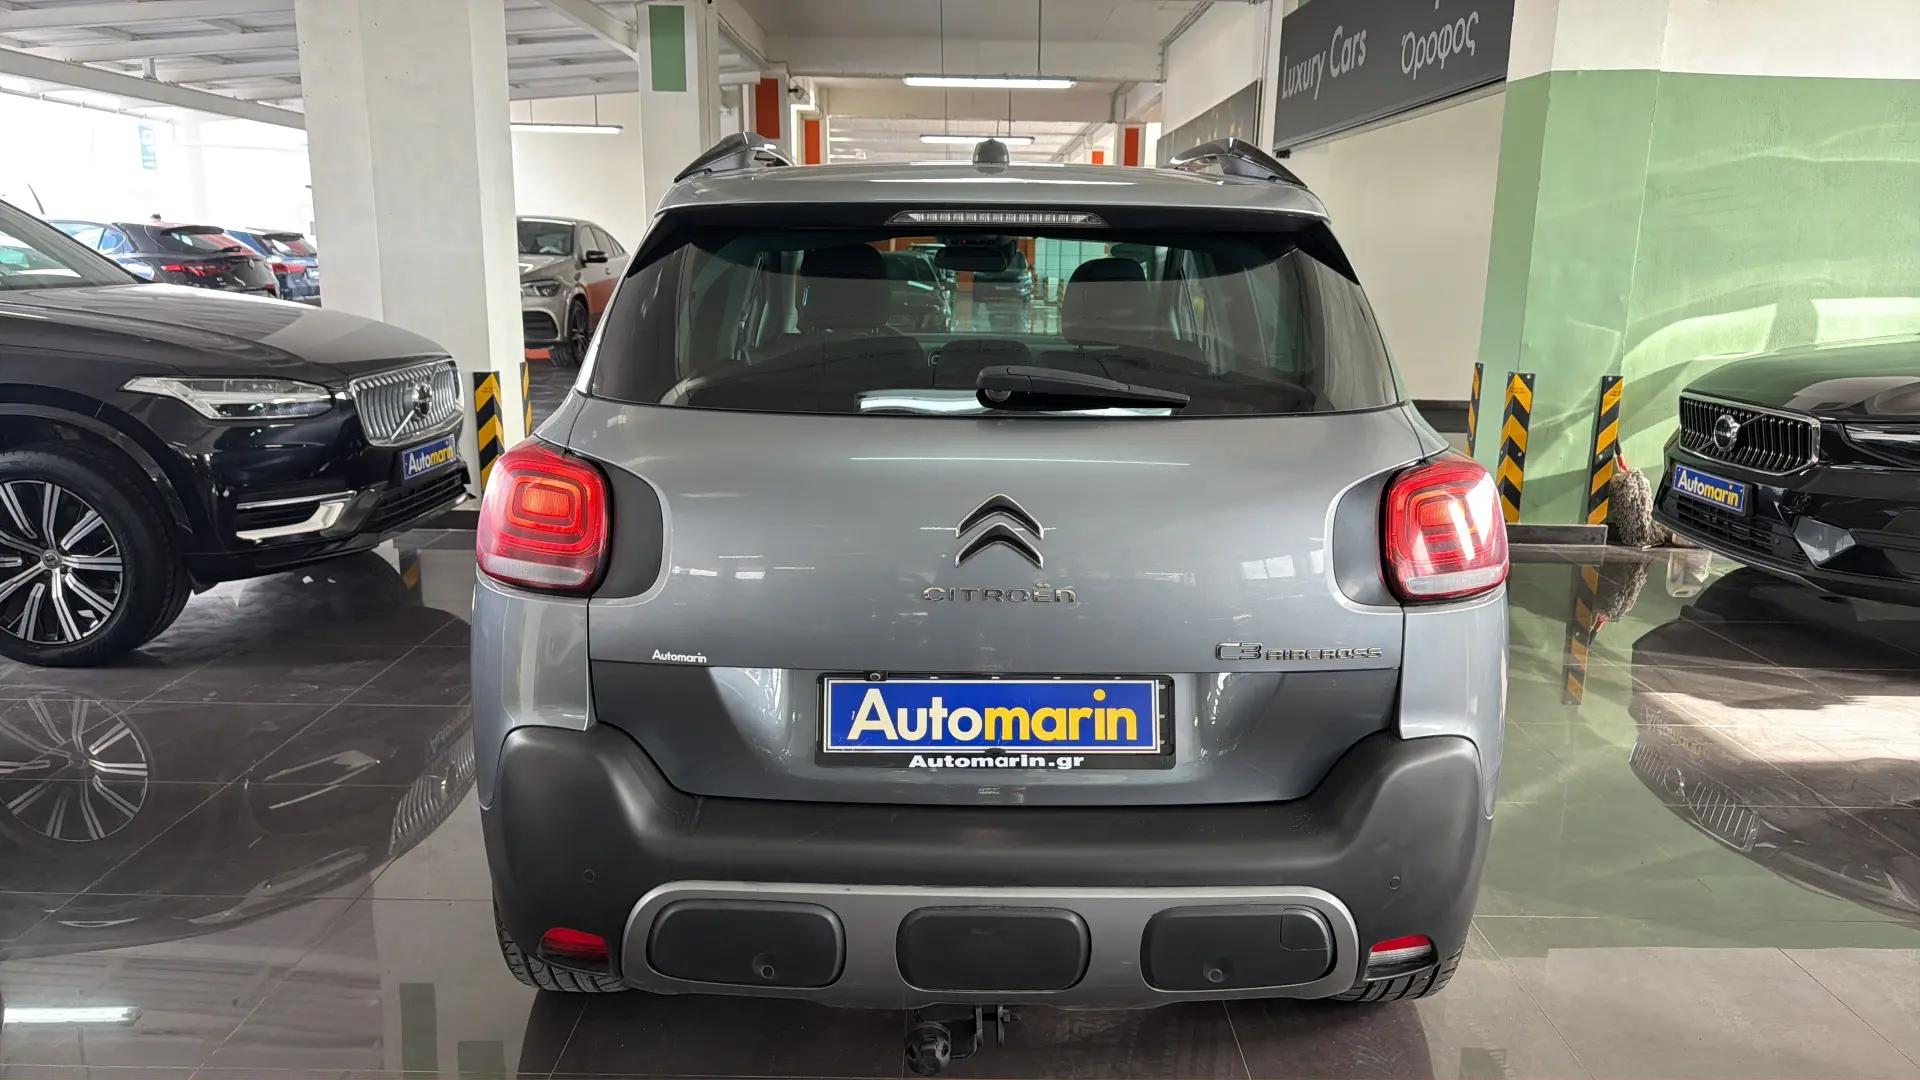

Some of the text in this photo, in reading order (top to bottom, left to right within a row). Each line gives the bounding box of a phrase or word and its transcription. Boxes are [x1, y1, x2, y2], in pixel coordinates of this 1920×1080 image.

[1282, 25, 1367, 99] Luxury Cars
[408, 441, 454, 475] Automarin
[1678, 469, 1738, 507] Automarin
[652, 649, 707, 663] Automarin
[1216, 642, 1382, 660] C3 AIRCROSS
[847, 688, 1138, 741] Automarin
[908, 754, 1085, 769] Automarin.gr
